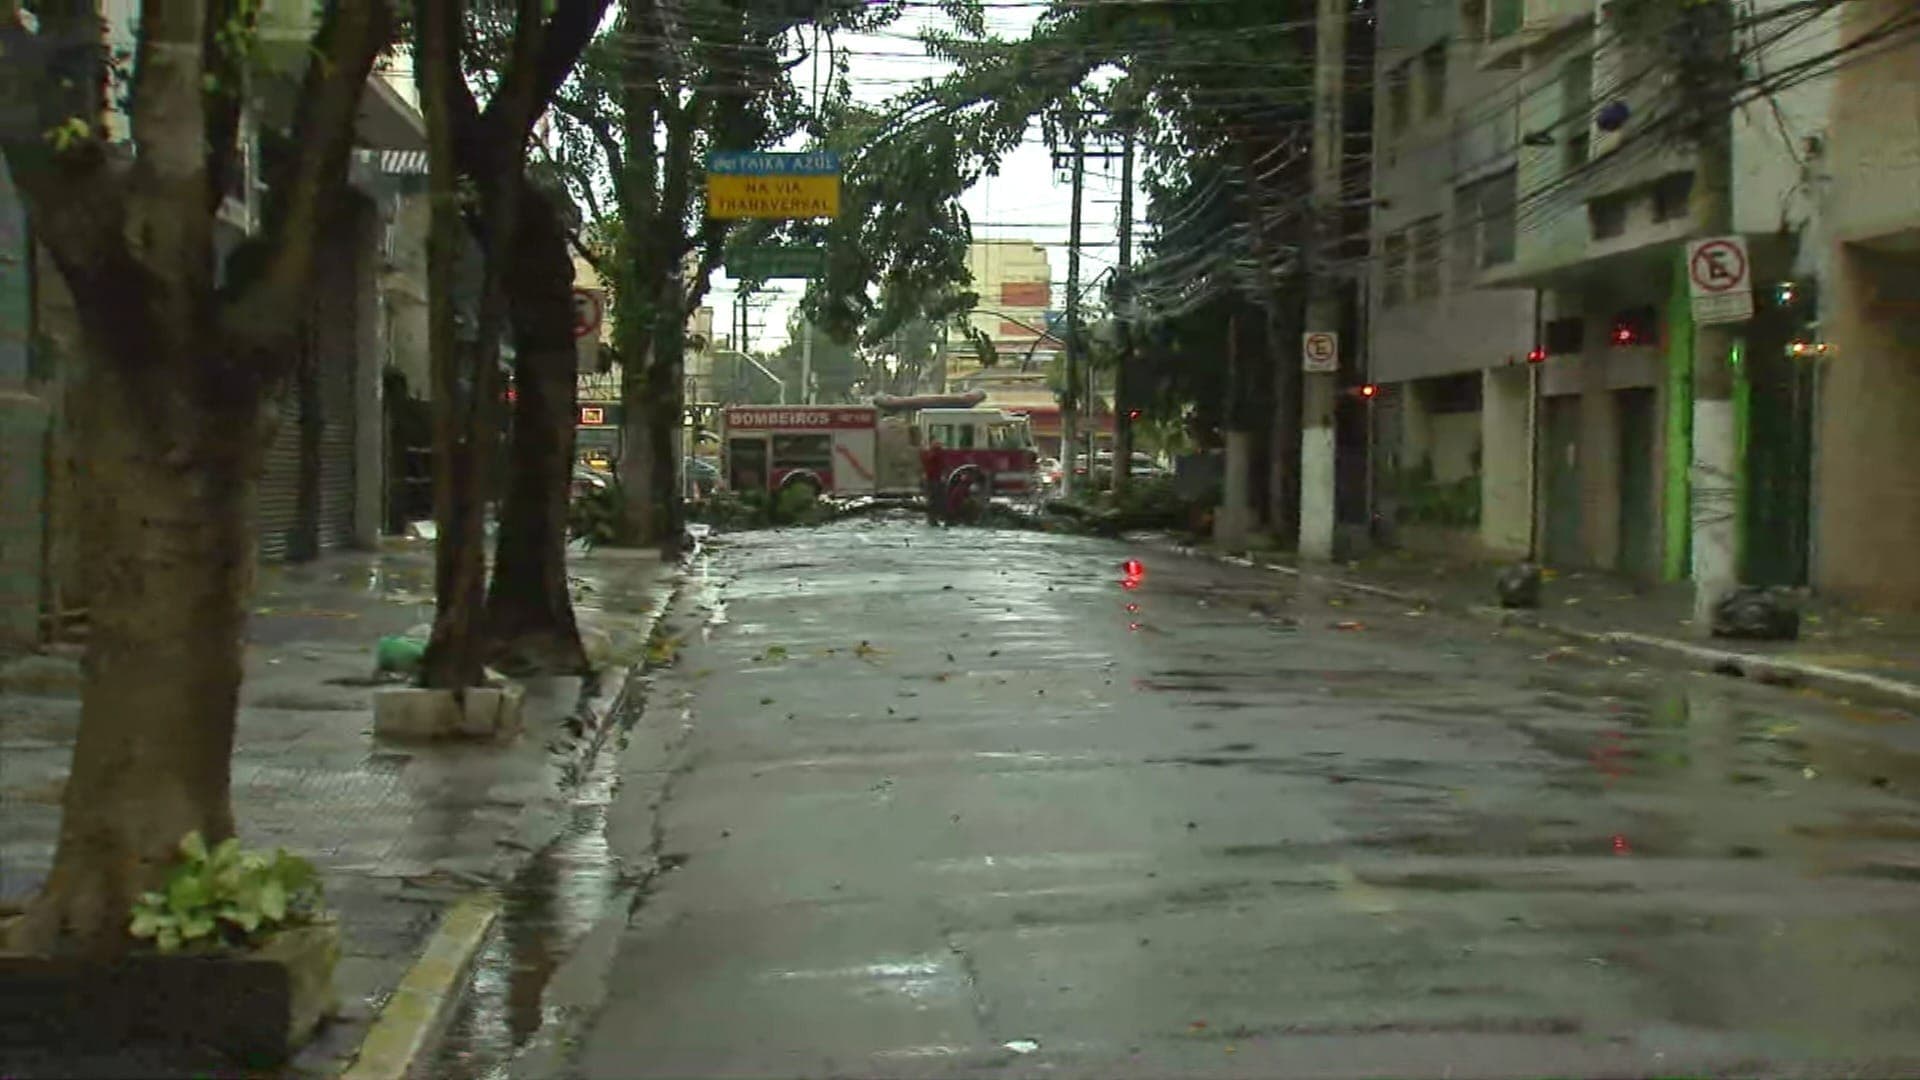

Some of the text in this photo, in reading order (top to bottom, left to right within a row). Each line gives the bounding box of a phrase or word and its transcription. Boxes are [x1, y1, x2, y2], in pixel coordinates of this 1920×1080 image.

[793, 154, 834, 169] AZUL
[745, 182, 802, 194] NA VIA
[729, 411, 830, 425] BOMBEIROS
